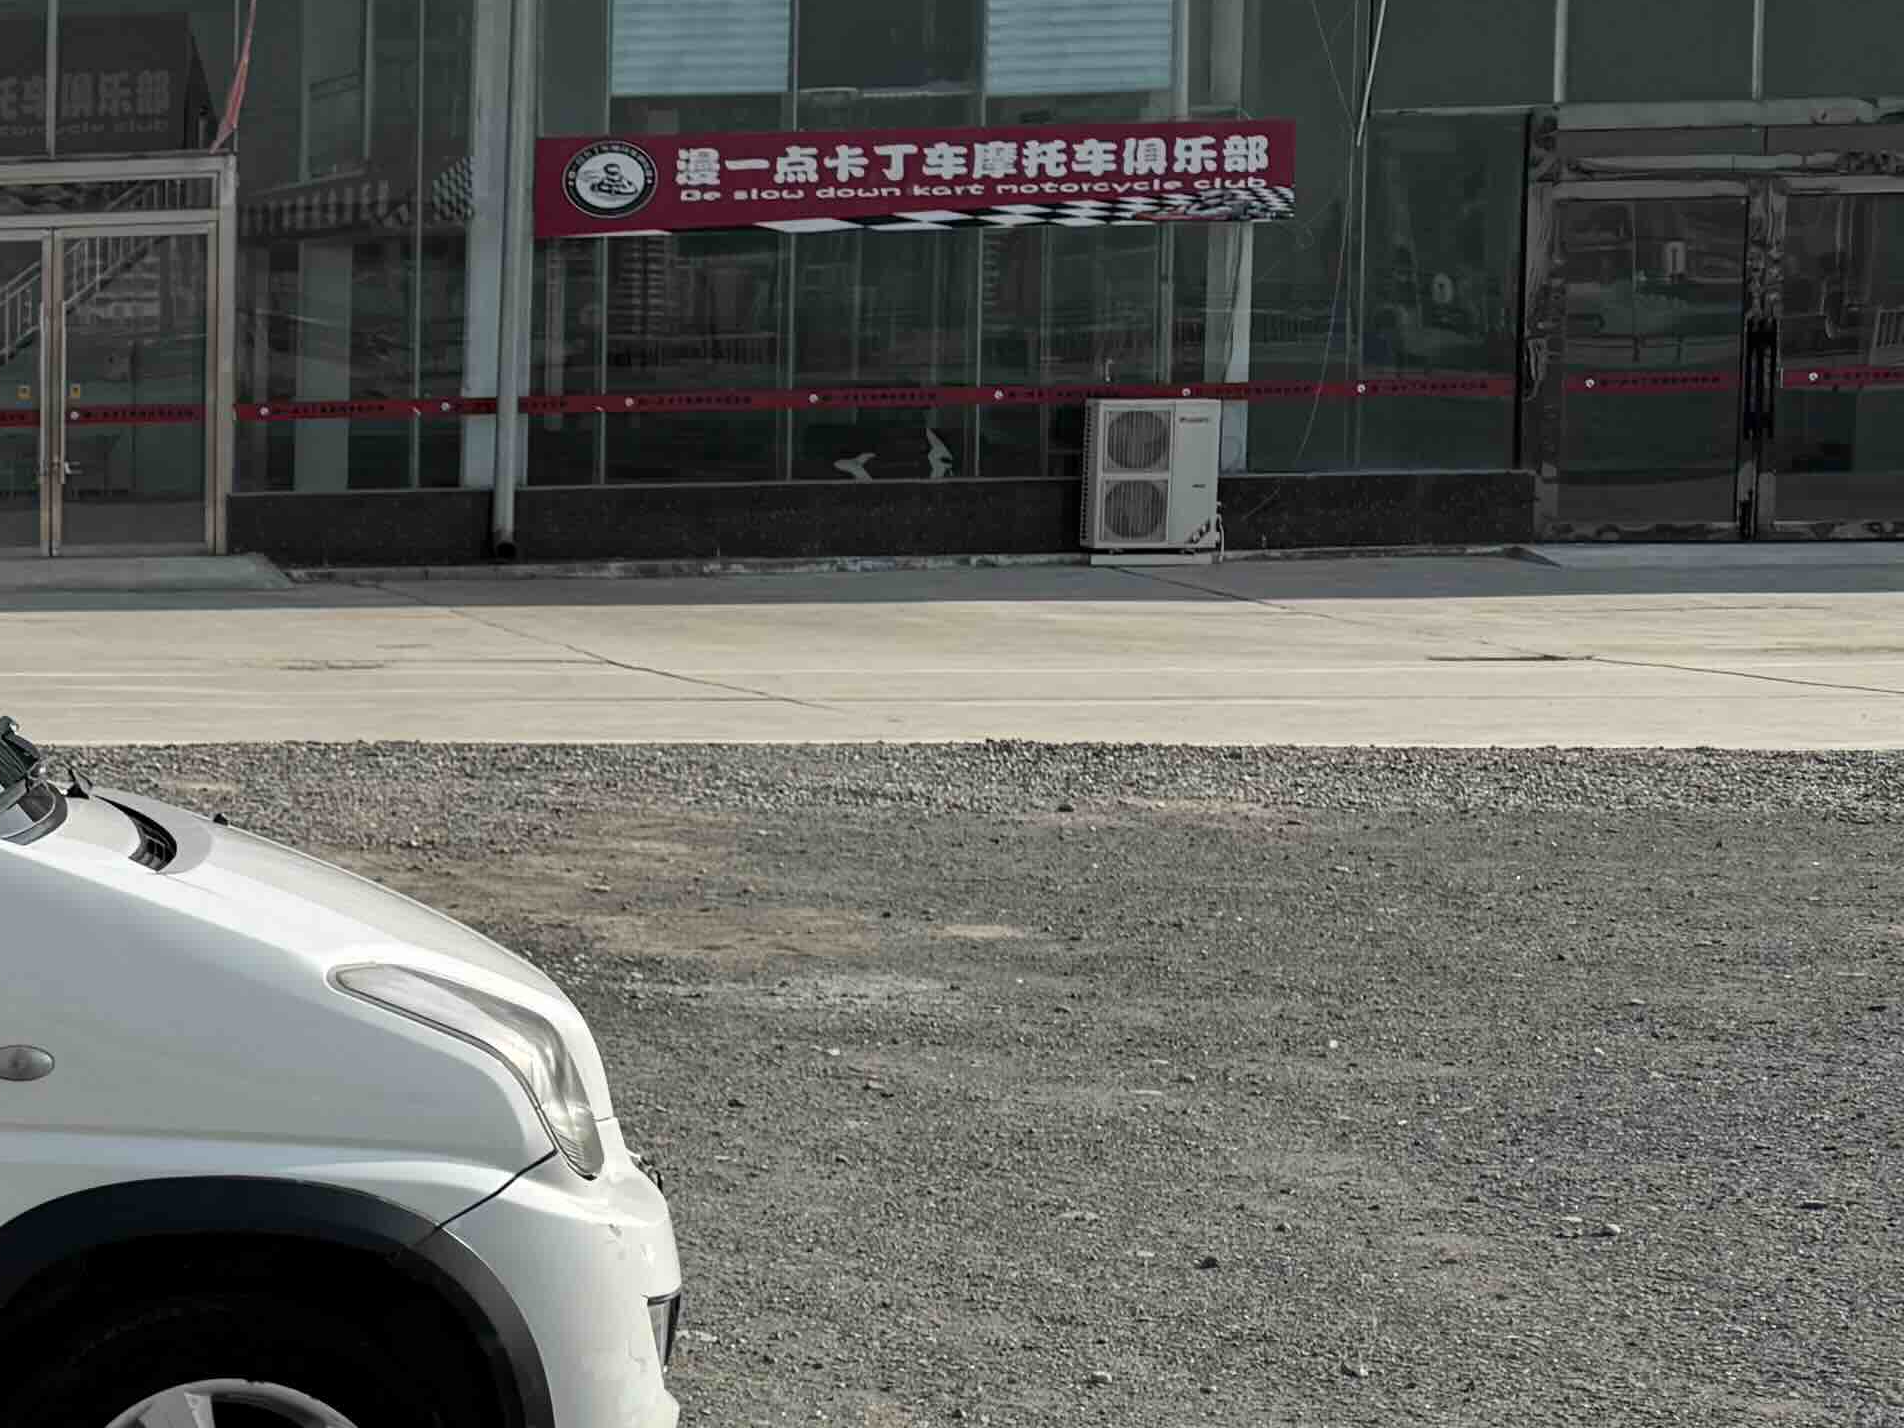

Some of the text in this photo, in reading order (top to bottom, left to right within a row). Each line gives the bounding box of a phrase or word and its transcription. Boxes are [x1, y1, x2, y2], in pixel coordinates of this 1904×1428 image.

[674, 134, 1269, 185] 漫一点卡丁车摩托车俱乐部
[733, 186, 805, 201] slow
[815, 185, 902, 200] down
[912, 183, 985, 197] kart
[996, 177, 1183, 195] motorcycle
[1194, 176, 1268, 190] club
